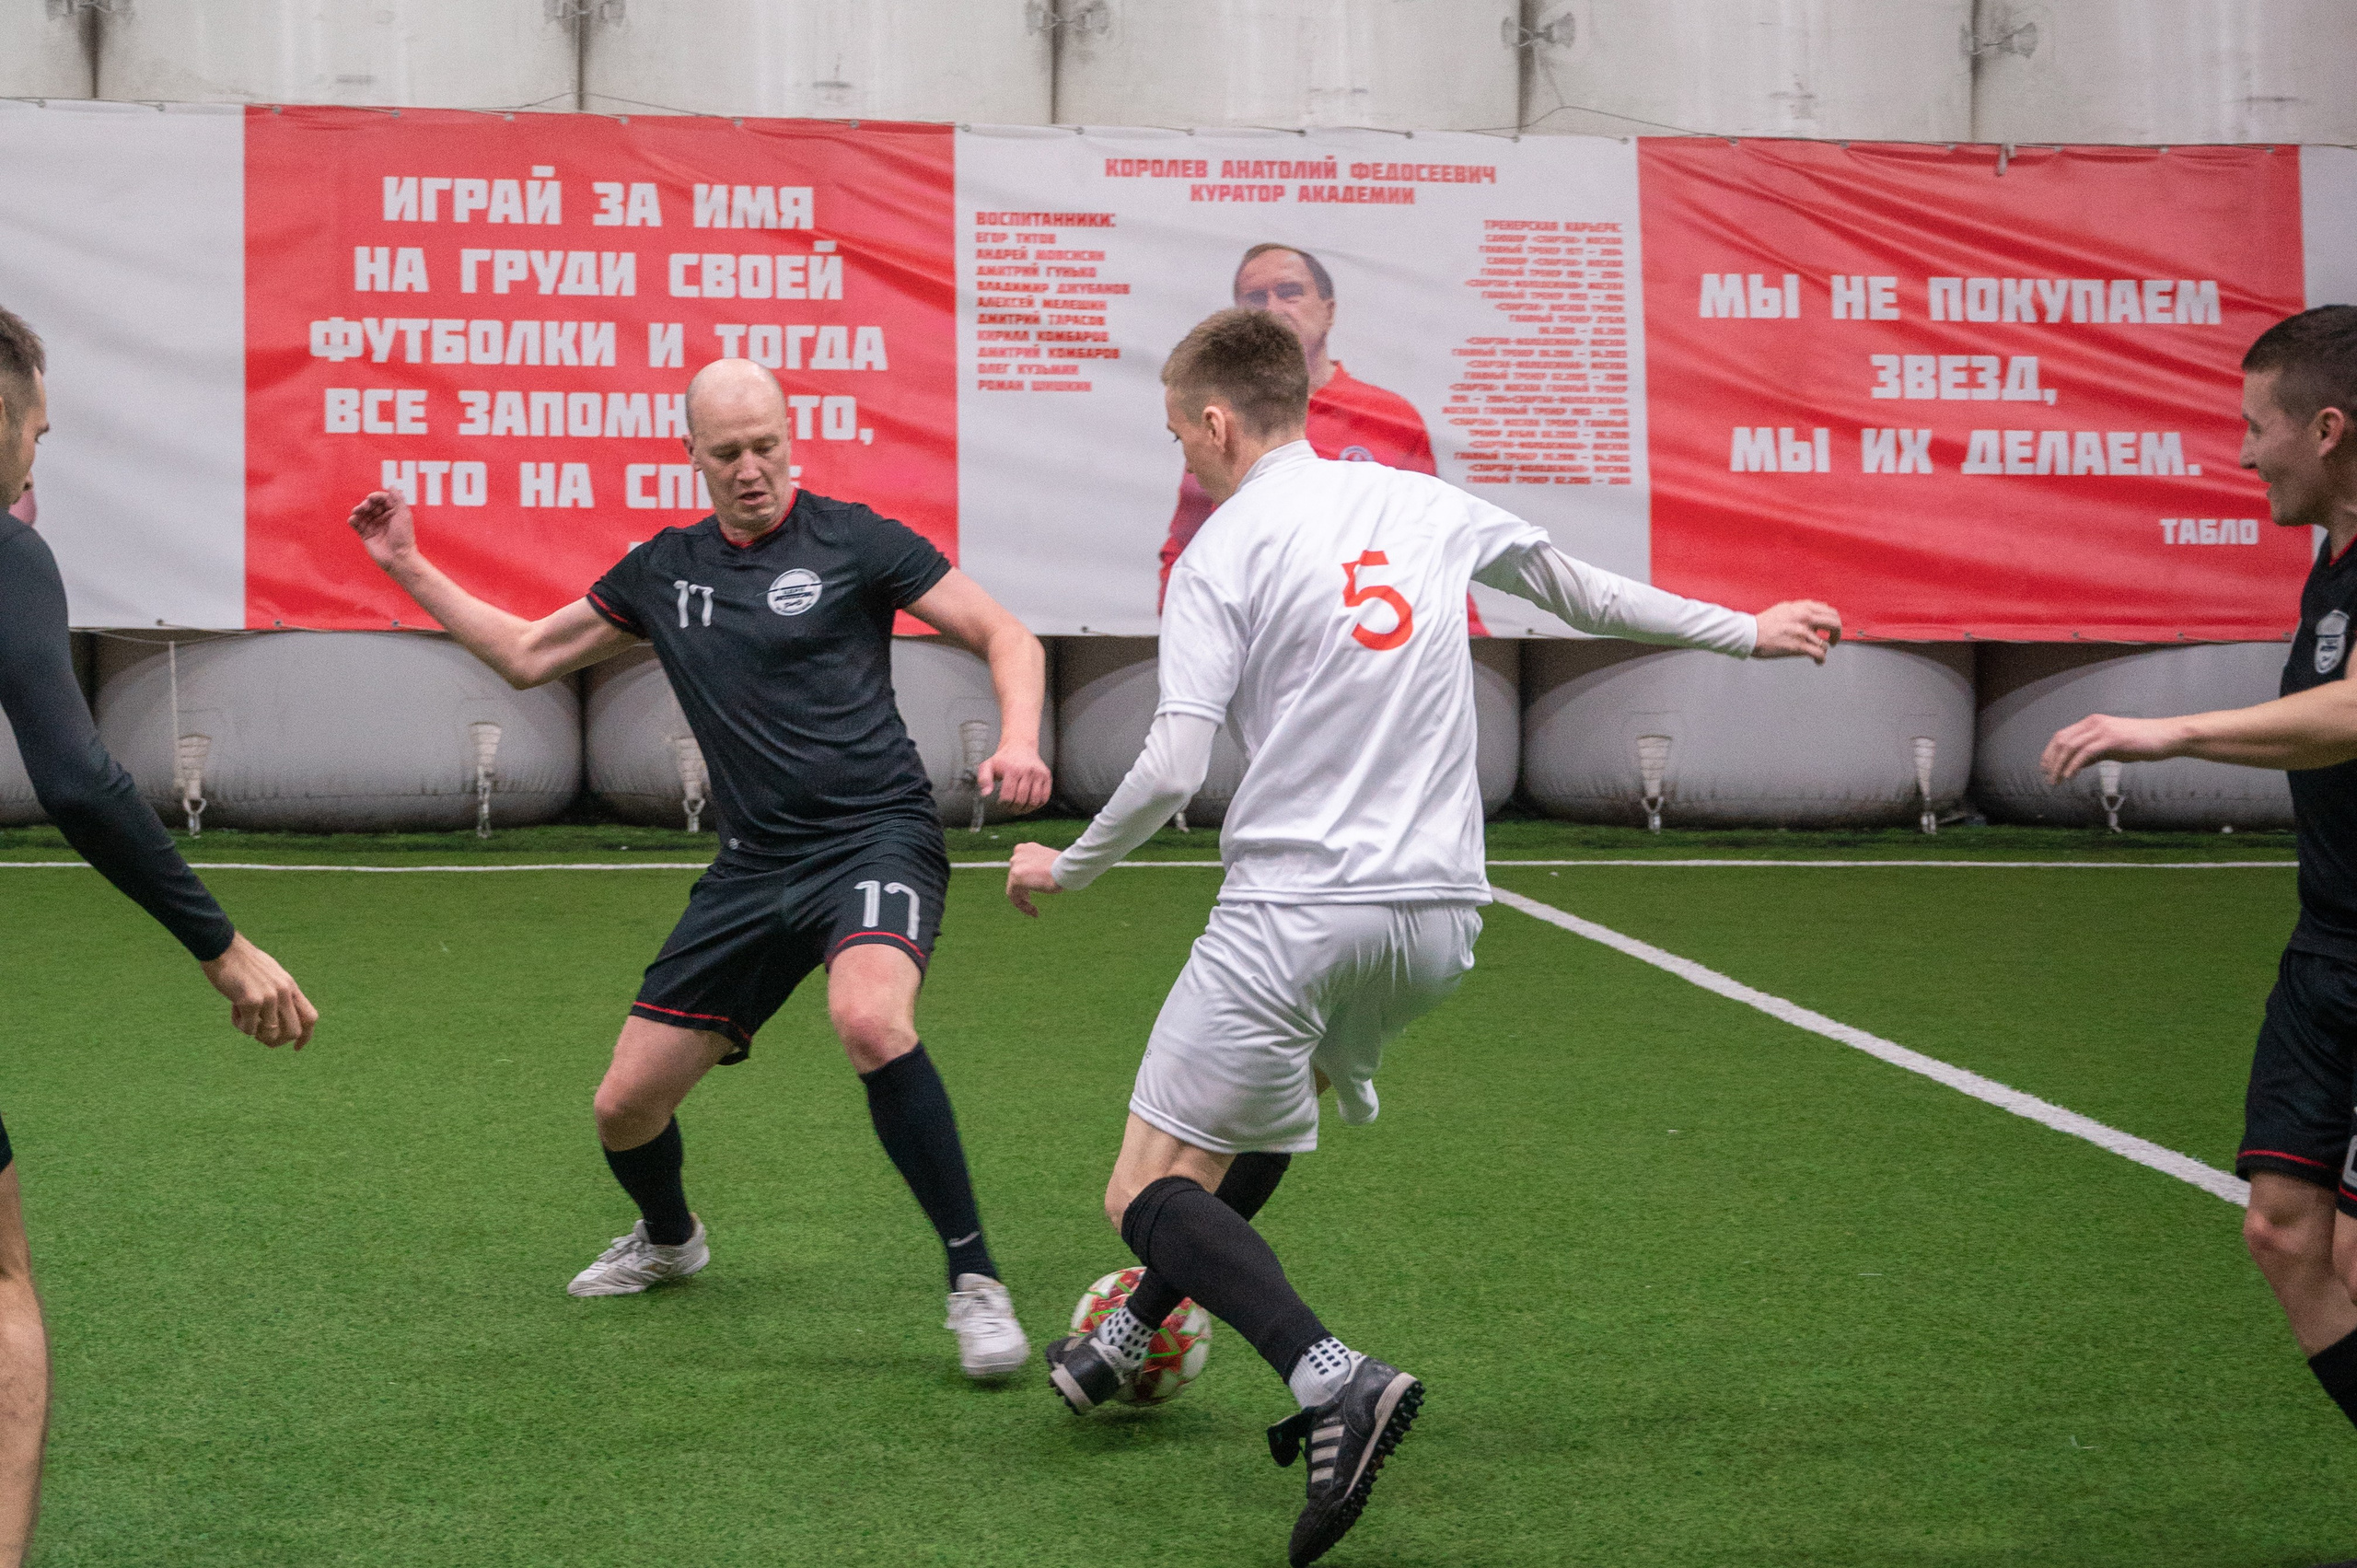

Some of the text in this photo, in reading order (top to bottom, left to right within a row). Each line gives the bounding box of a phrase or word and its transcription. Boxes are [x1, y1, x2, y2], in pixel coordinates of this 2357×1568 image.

[1104, 155, 1497, 184] КОРОЛЕВ АНАТОЛИЙ ФЕДОСЕЕВИЧ
[1190, 183, 1416, 205] КУРАТОР АКАДЕМИИ
[382, 165, 815, 230] ИГРАЙ ЗА ИМЯ
[974, 211, 1116, 228] ВОСПИТАННИКИ:
[354, 240, 843, 301] НА ГРУДИ СВОЕЙ
[1698, 273, 2221, 325] МЫ НЕ ПОКУПАЕМ
[308, 316, 888, 372] ФУТБОЛКИ И ТОГДА
[1870, 354, 2057, 405] ЗВЕЗД,
[324, 388, 428, 435] ВСЕ
[1730, 426, 2202, 477] МЫ ИХ ДЕЛАЕМ.
[381, 459, 487, 507] ЧТО
[519, 461, 595, 508] НА
[2160, 517, 2258, 546] ТАБЛО
[673, 579, 715, 629] 17
[1341, 550, 1414, 651] 5
[853, 880, 921, 941] 17
